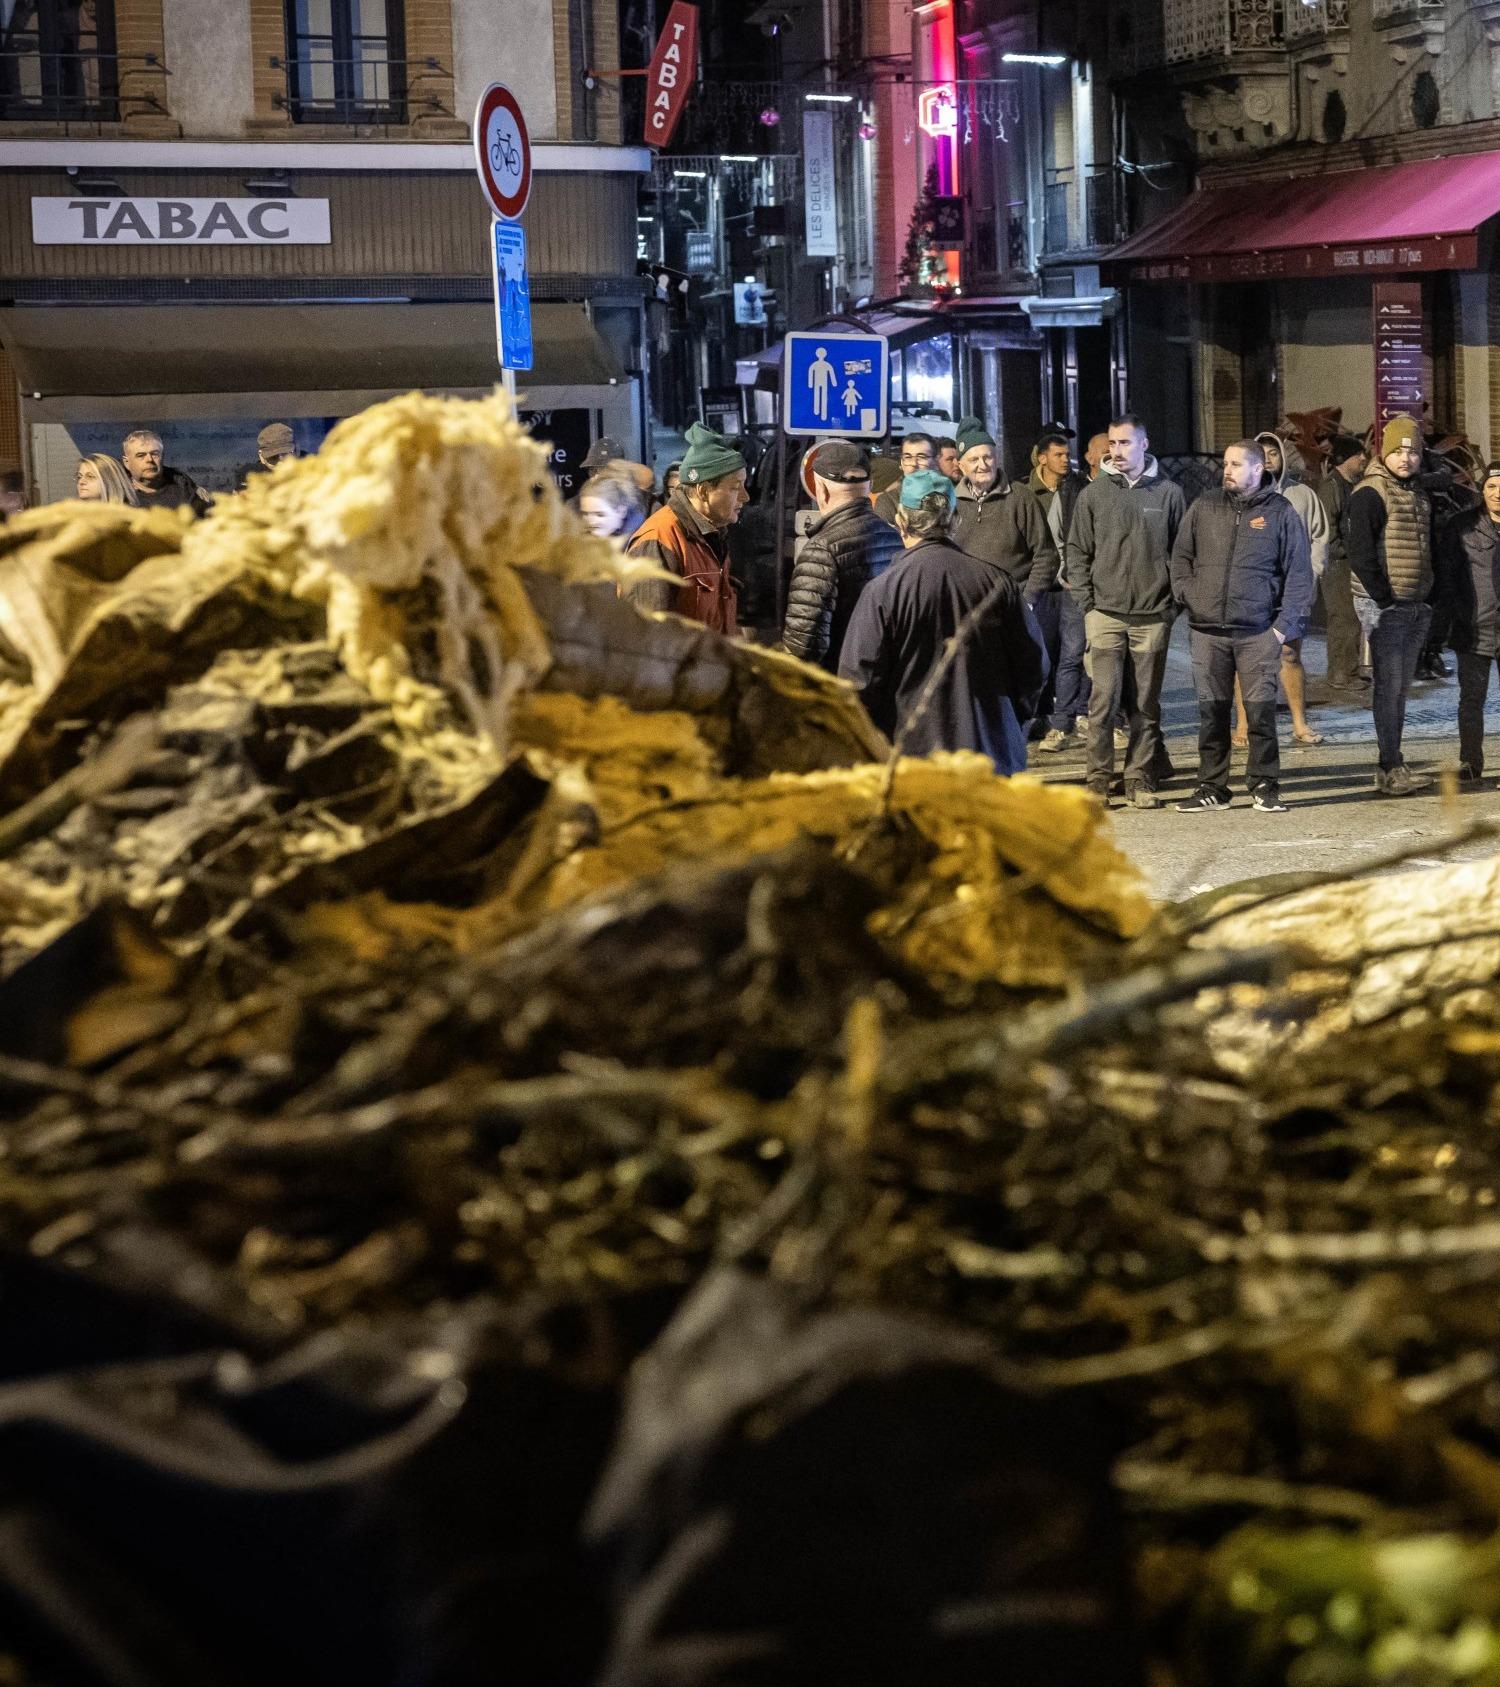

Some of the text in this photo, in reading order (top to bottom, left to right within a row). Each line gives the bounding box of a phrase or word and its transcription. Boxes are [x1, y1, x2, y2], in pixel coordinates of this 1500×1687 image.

[653, 23, 685, 129] TABAC
[809, 158, 822, 212] DELICES
[68, 201, 290, 239] TABAC
[811, 214, 822, 239] LES
